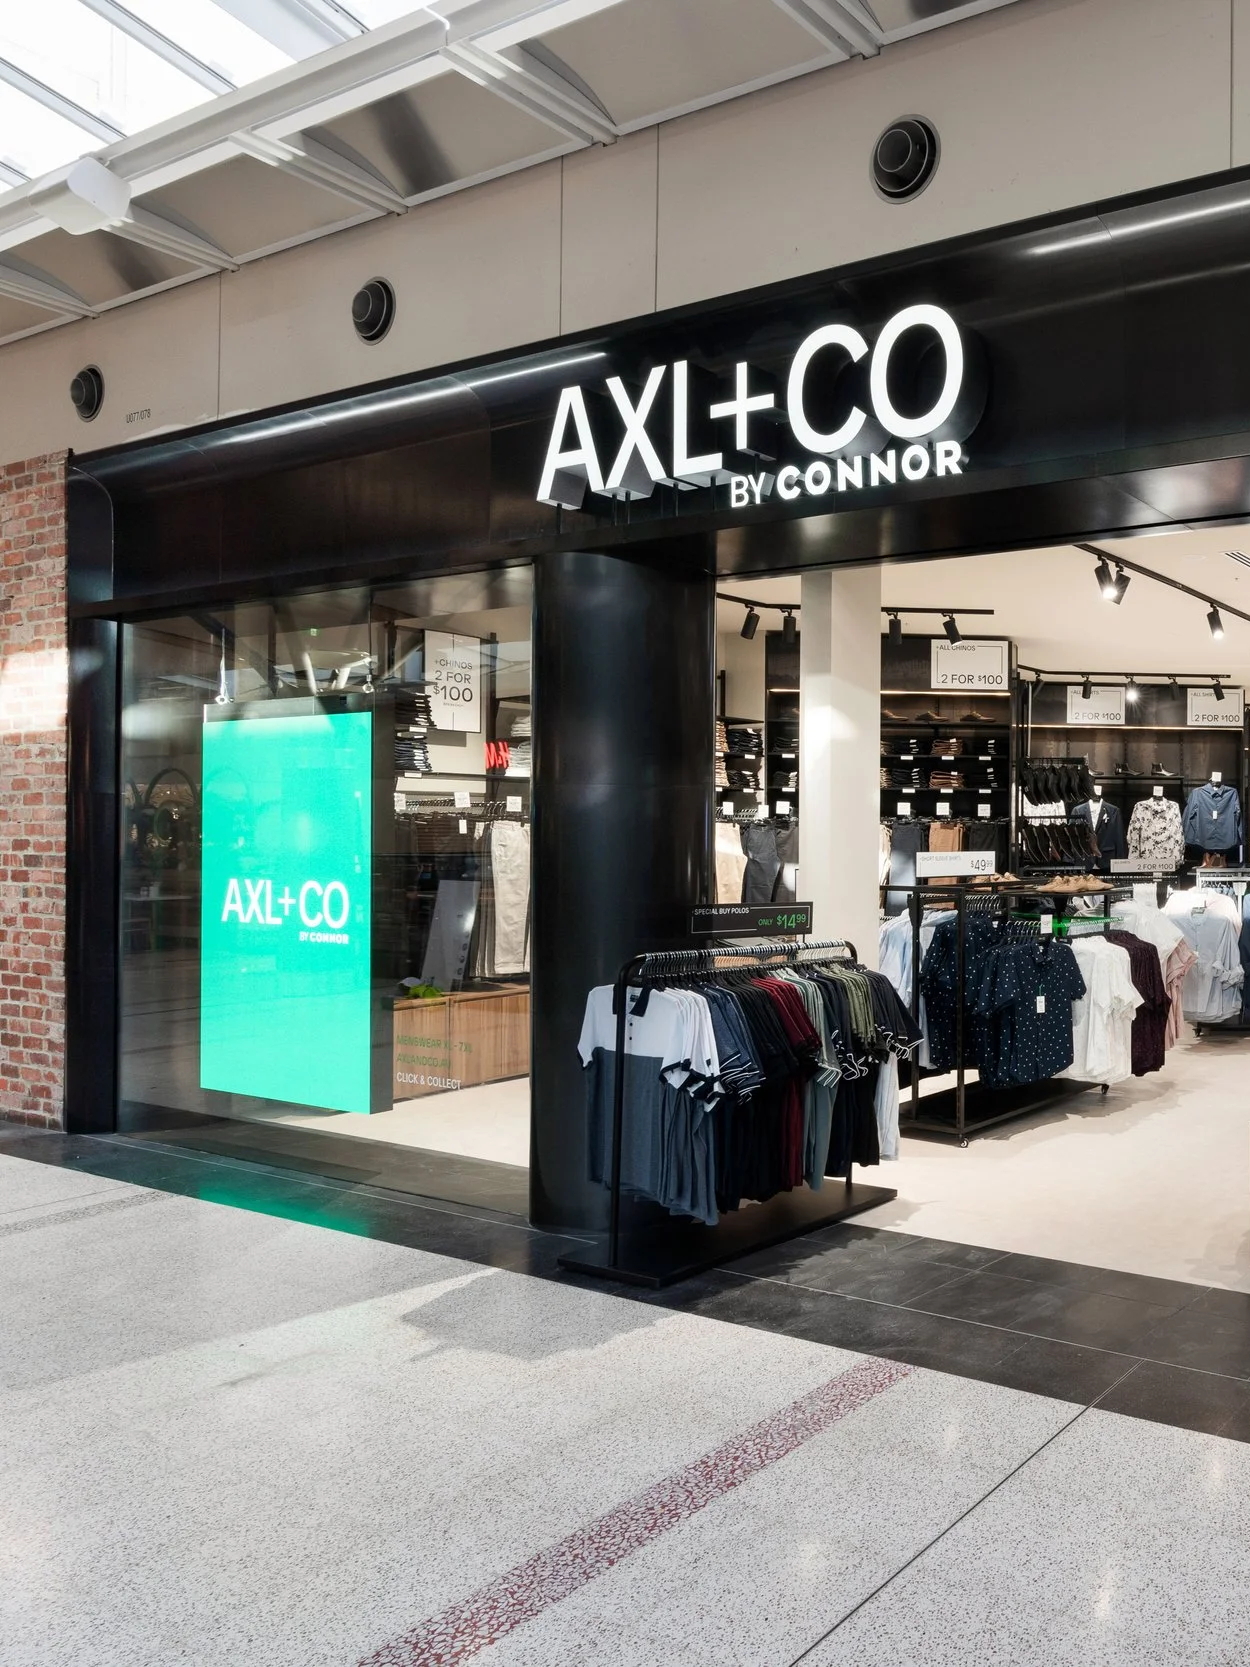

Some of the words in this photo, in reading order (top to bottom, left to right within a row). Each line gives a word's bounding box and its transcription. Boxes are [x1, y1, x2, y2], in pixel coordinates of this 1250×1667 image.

[537, 304, 964, 501] AXL+CO
[730, 472, 768, 508] BY
[776, 440, 964, 500] CONNOR
[435, 670, 442, 681] 2
[446, 671, 472, 684] FOR
[941, 673, 948, 684] 2
[951, 674, 974, 685] FOR
[978, 674, 1003, 685] $100
[433, 685, 473, 703] $100
[1074, 712, 1080, 720] 2
[1082, 712, 1100, 721] FOR
[1102, 712, 1121, 721] $100
[1194, 714, 1200, 722] 2
[1202, 714, 1219, 722] FOR
[1221, 714, 1240, 723] $100
[221, 878, 349, 929] AXL+CO
[719, 907, 731, 915] BUY
[758, 918, 774, 926] ONLY
[299, 931, 309, 942] BY
[309, 932, 349, 945] CONNOR
[396, 1071, 419, 1084] CLICK
[420, 1074, 425, 1085] &
[427, 1075, 462, 1090] COLLECT
